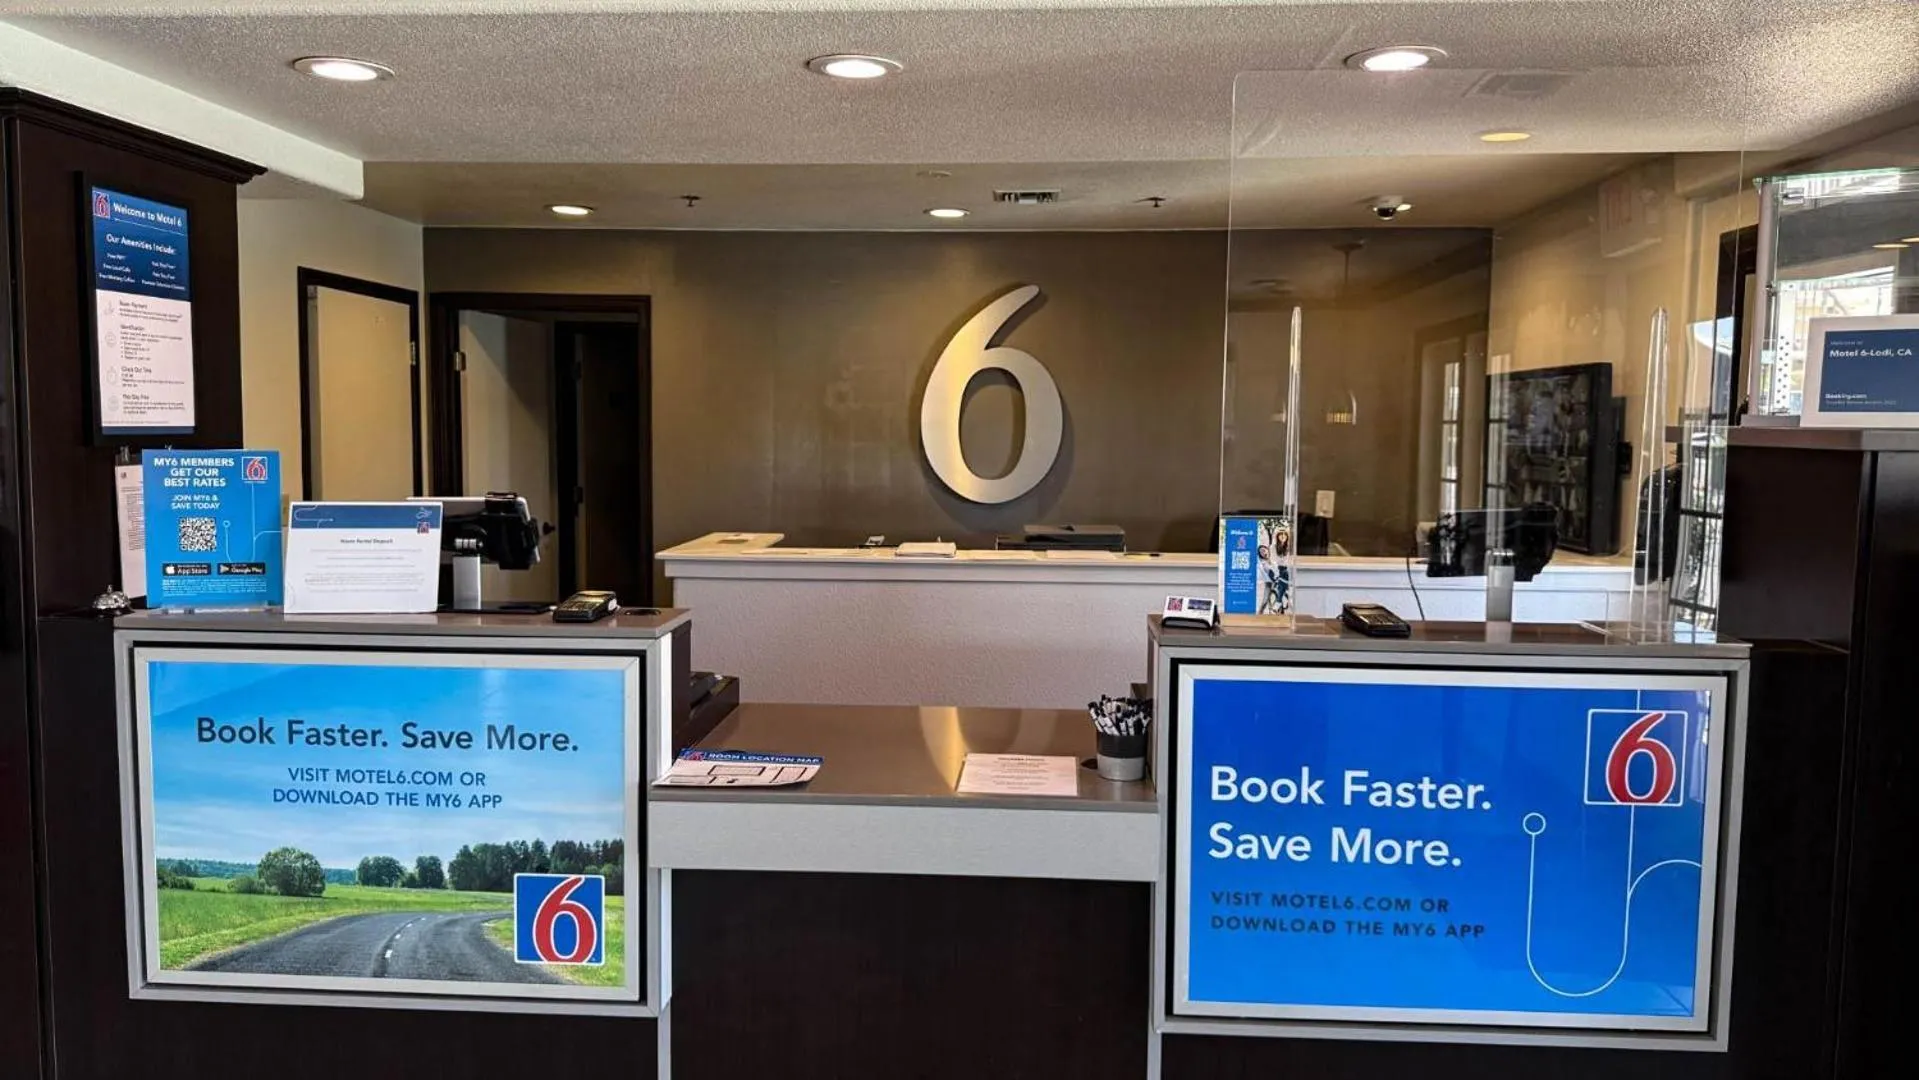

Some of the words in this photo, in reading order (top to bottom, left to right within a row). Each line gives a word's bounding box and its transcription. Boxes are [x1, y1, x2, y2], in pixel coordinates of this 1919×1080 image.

[113, 202, 145, 218] Welcome
[147, 212, 155, 221] to
[156, 213, 176, 225] Motel
[177, 218, 183, 227] 6
[106, 233, 119, 243] Our
[120, 236, 152, 251] Amenities
[1829, 349, 1858, 357] Motel
[1860, 348, 1894, 357] 6-Lodi,
[1897, 348, 1912, 356] CA
[921, 284, 1064, 504] 6
[154, 458, 178, 466] MY6
[181, 458, 235, 467] MEMBERS
[170, 468, 191, 477] GET
[195, 468, 219, 477] OUR
[247, 457, 266, 480] 6
[164, 478, 191, 487] BEST
[193, 478, 226, 487] RATES
[178, 567, 191, 575] App
[231, 567, 250, 575] Google
[197, 716, 276, 747] Book
[287, 719, 388, 748] Faster.
[401, 722, 473, 750] Save
[487, 724, 579, 753] More.
[741, 755, 793, 763] LOCATION
[1605, 711, 1677, 804] 6
[288, 767, 330, 783] VISIT
[336, 768, 453, 787] MOTEL6.COM
[460, 771, 486, 787] OR
[1210, 765, 1325, 805] Book
[1344, 769, 1492, 810] Faster.
[272, 788, 379, 807] DOWNLOAD
[389, 791, 420, 807] THE
[426, 793, 462, 809] MY6
[468, 794, 503, 809] APP
[1208, 822, 1312, 861] Save
[1331, 827, 1462, 867] More.
[1211, 890, 1261, 908] VISIT
[1271, 892, 1411, 913] MOTEL6.COM
[1421, 898, 1449, 914] OR
[532, 875, 597, 963] 6
[1210, 915, 1335, 935] DOWNLOAD
[1346, 919, 1386, 936] THE
[1394, 921, 1437, 938] MY6
[1445, 923, 1485, 938] APP
